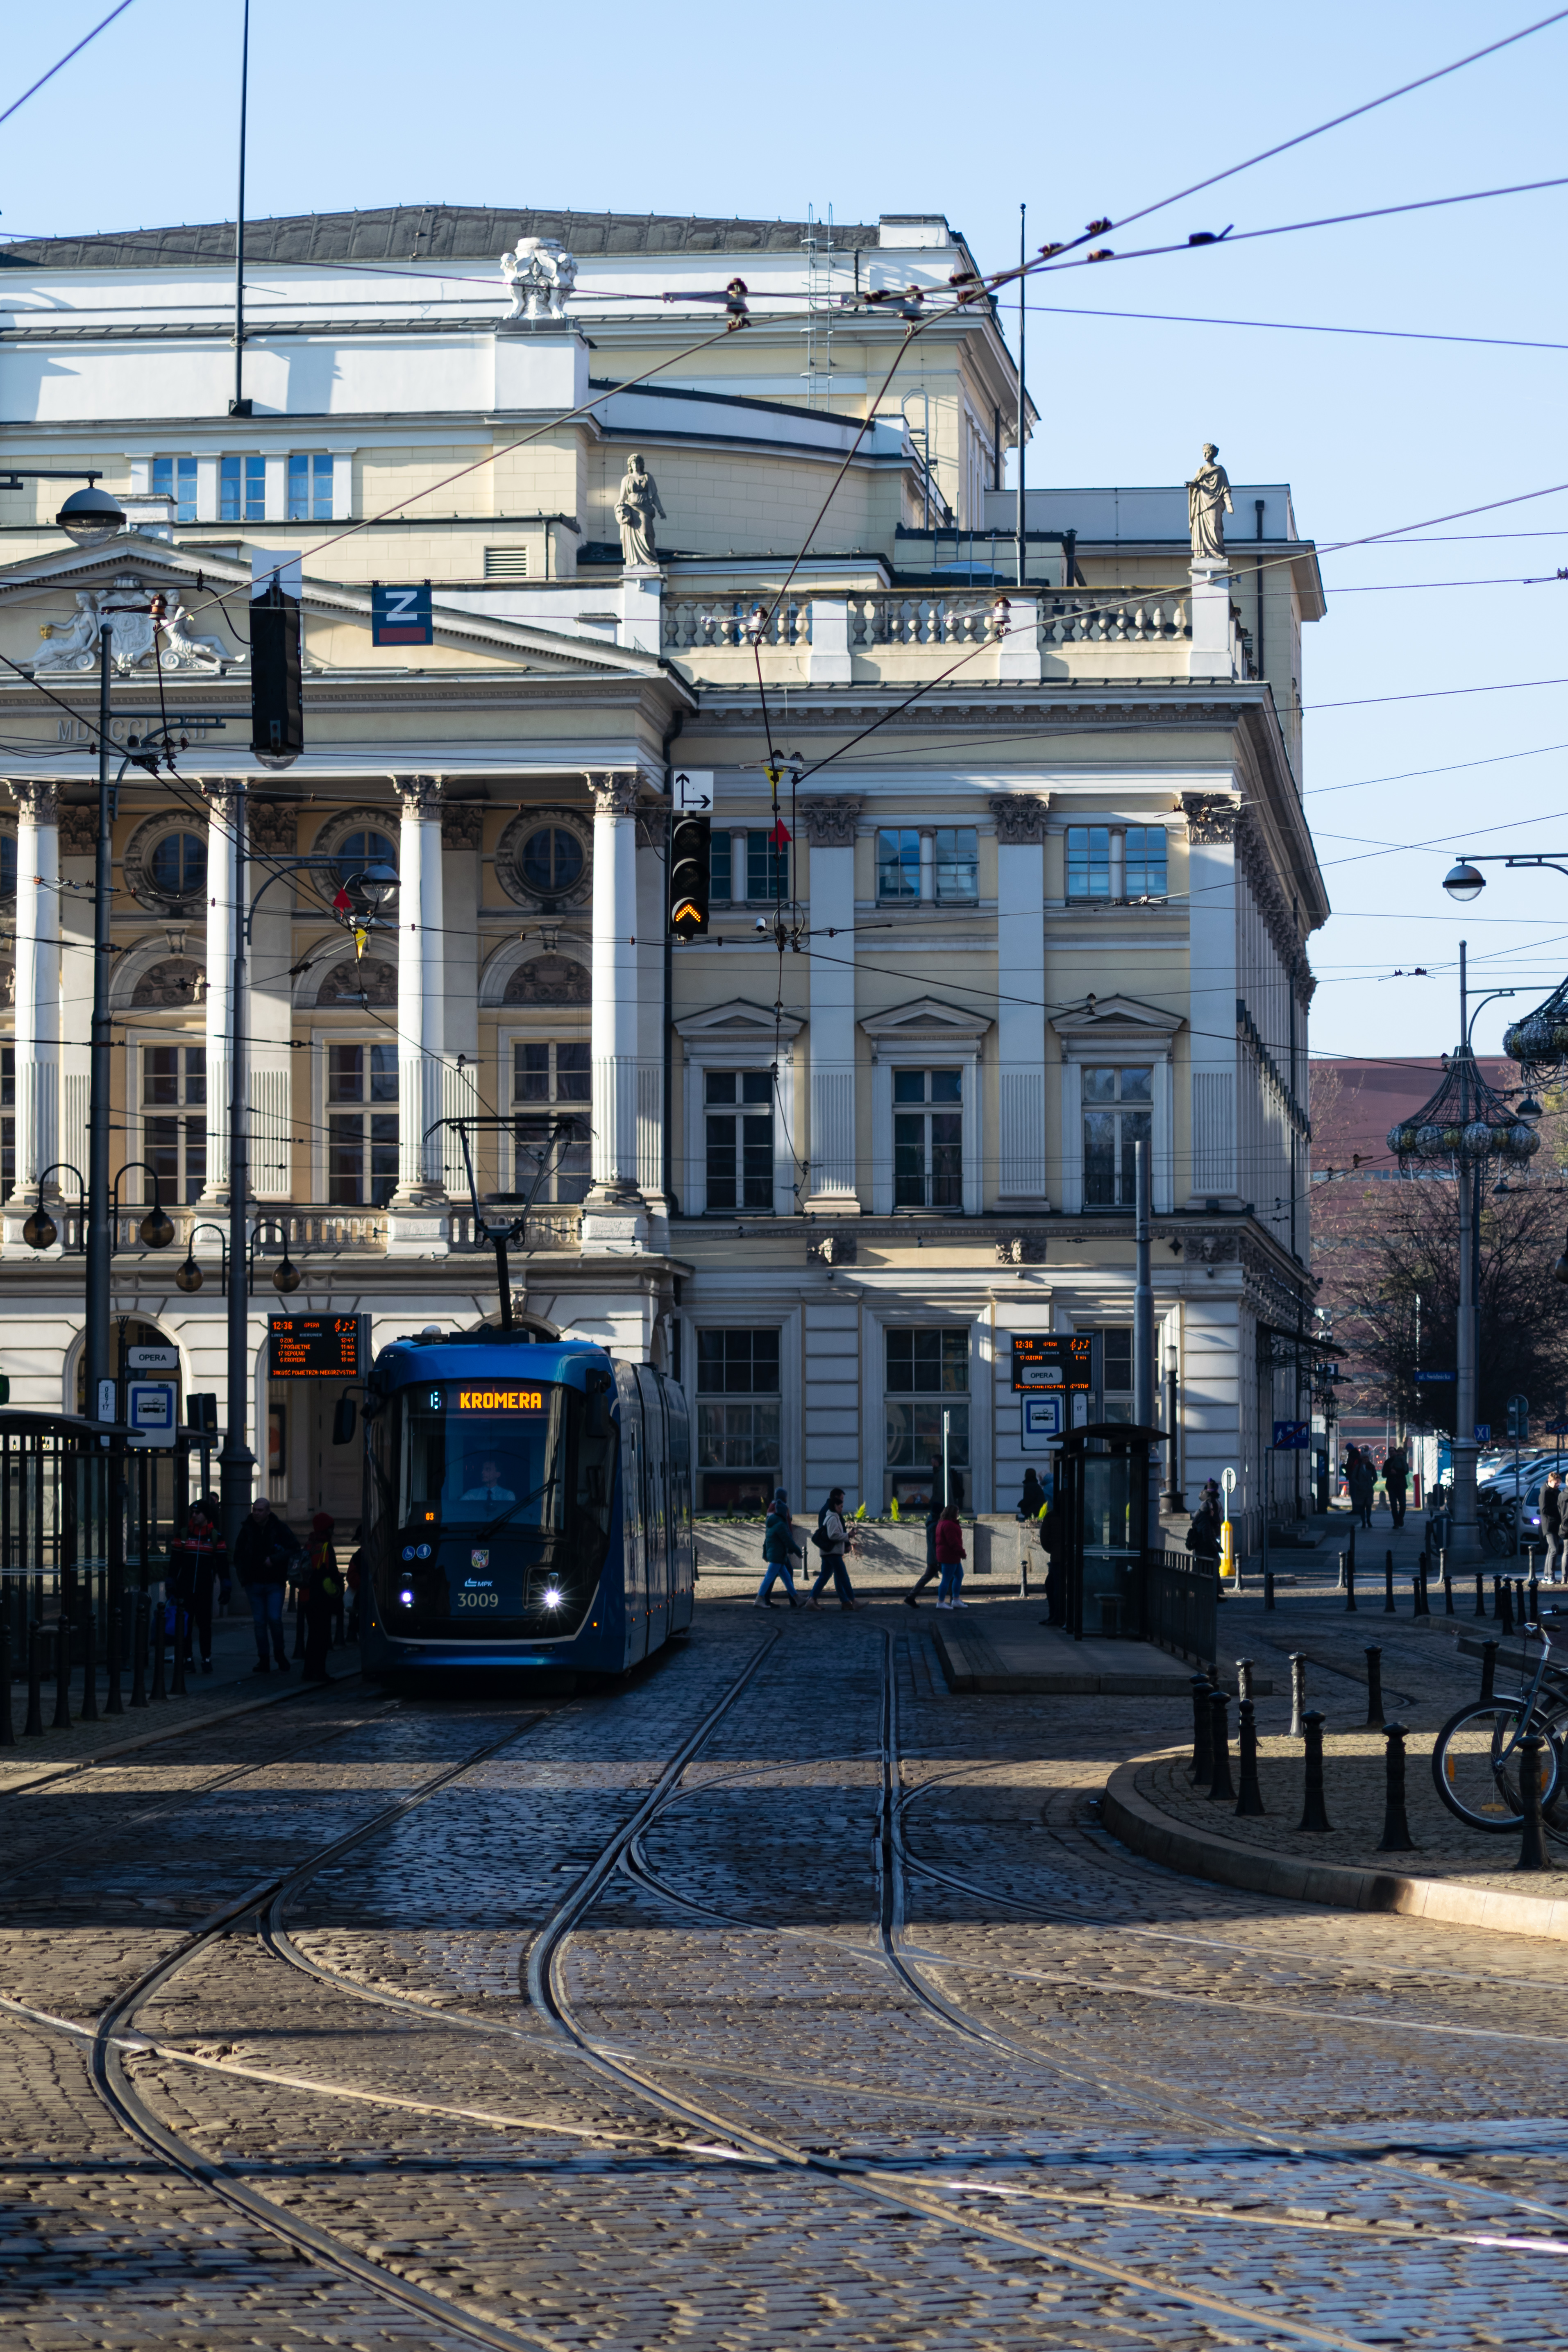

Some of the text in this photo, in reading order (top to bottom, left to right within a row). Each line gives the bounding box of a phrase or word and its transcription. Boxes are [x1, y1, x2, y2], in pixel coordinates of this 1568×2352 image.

[386, 591, 417, 621] Z
[273, 1322, 293, 1330] 12:36
[460, 1393, 541, 1408] KROMERA
[458, 1593, 498, 1607] 3009
